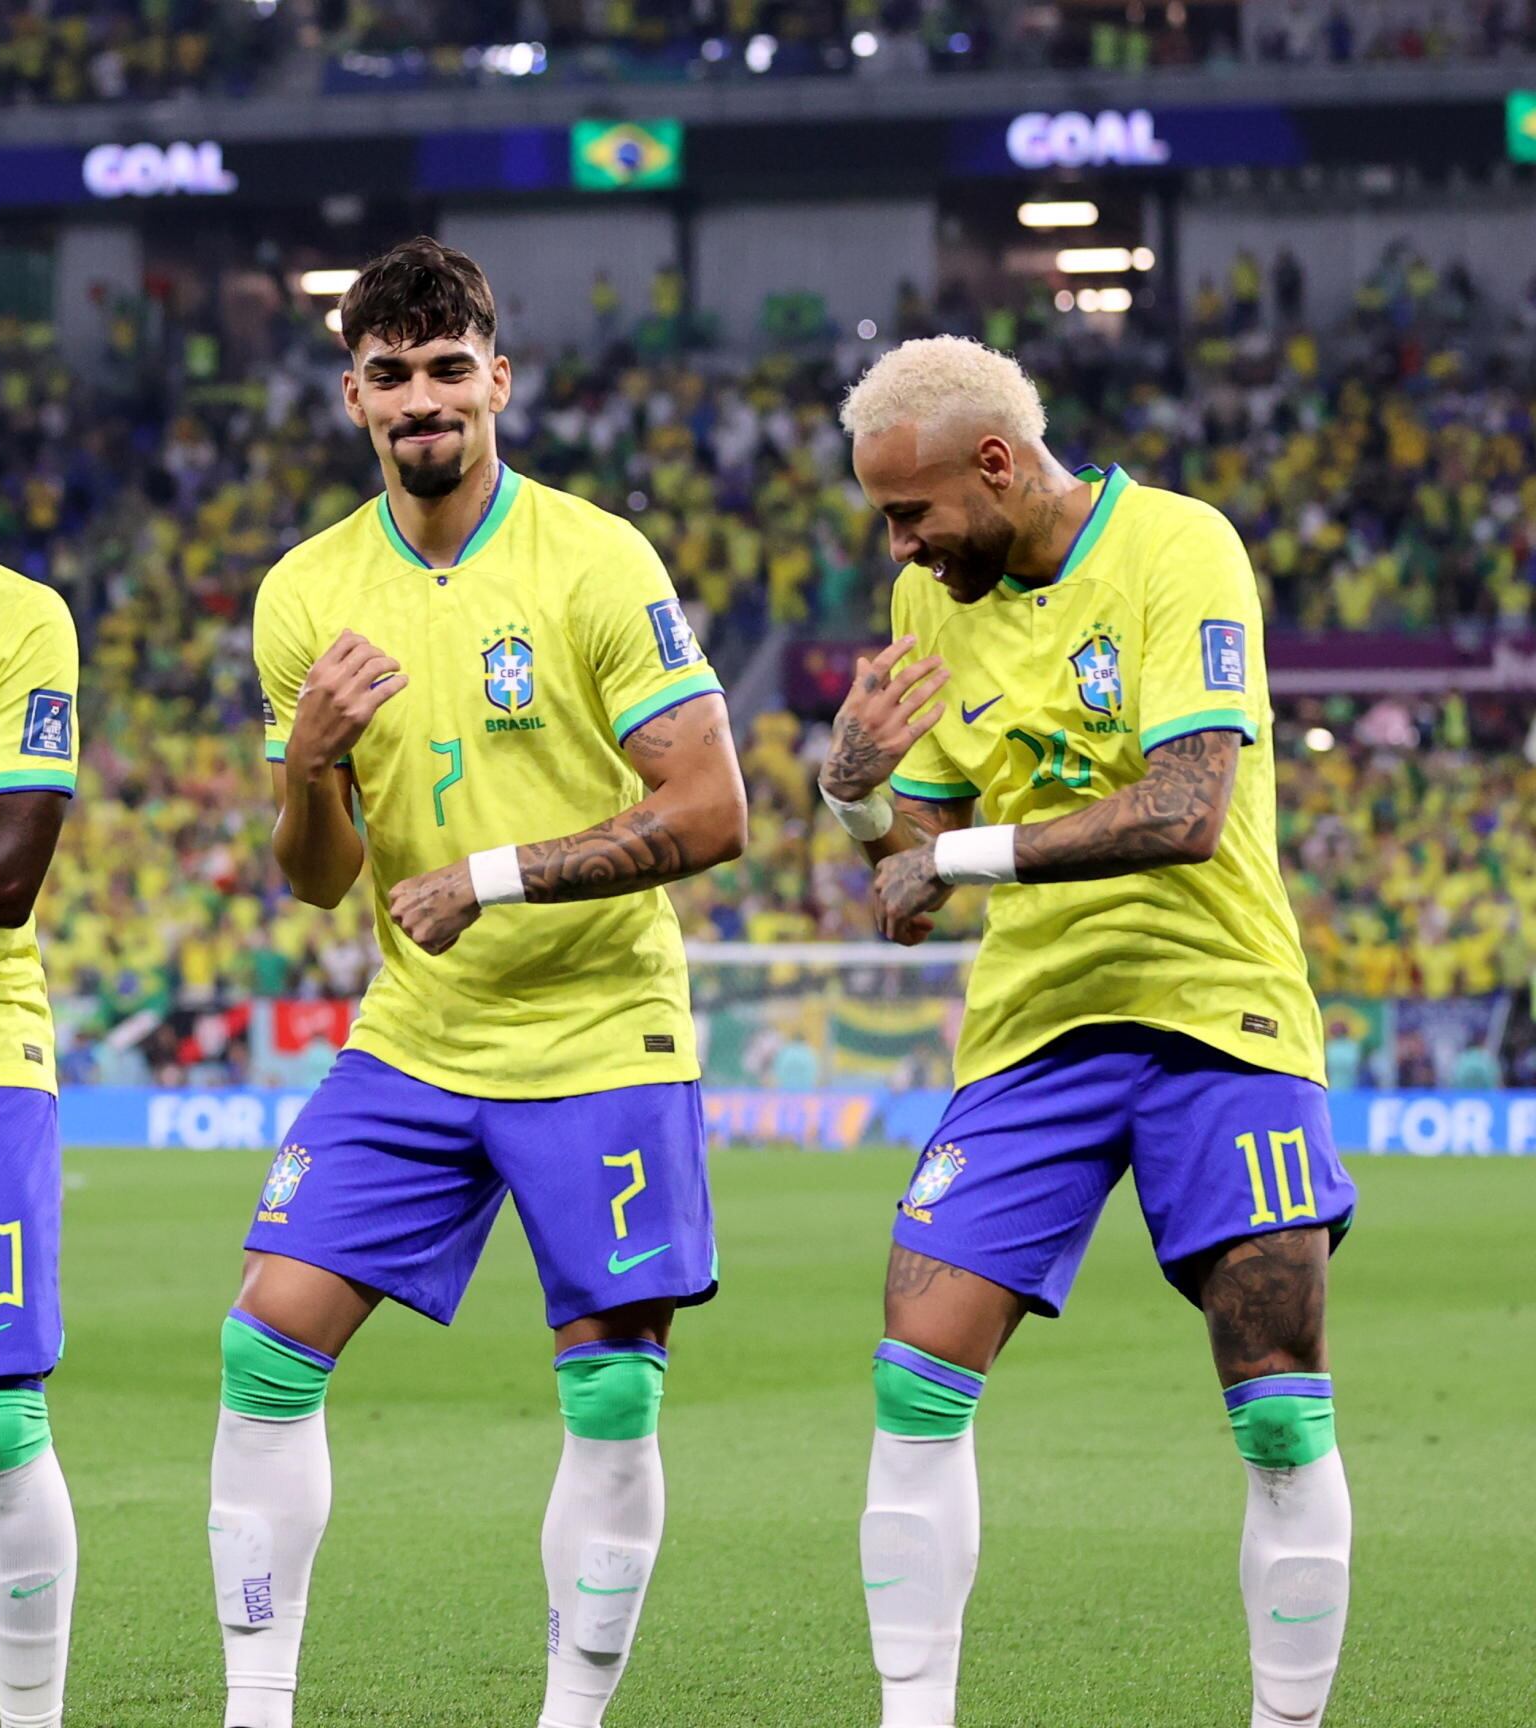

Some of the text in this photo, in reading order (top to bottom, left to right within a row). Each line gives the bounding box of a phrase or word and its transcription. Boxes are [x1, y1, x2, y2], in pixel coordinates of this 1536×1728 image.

[1006, 110, 1171, 168] GOAL
[82, 141, 239, 198] GOAL
[500, 668, 522, 678] CBF
[1093, 668, 1115, 680] CBF
[485, 716, 547, 733] BRASIL
[430, 737, 463, 828] 7
[149, 1095, 264, 1149] FOR
[1367, 1097, 1493, 1155] FOR
[602, 1149, 647, 1240] 7
[1234, 1126, 1317, 1227] 10
[242, 1572, 274, 1623] BRASIL
